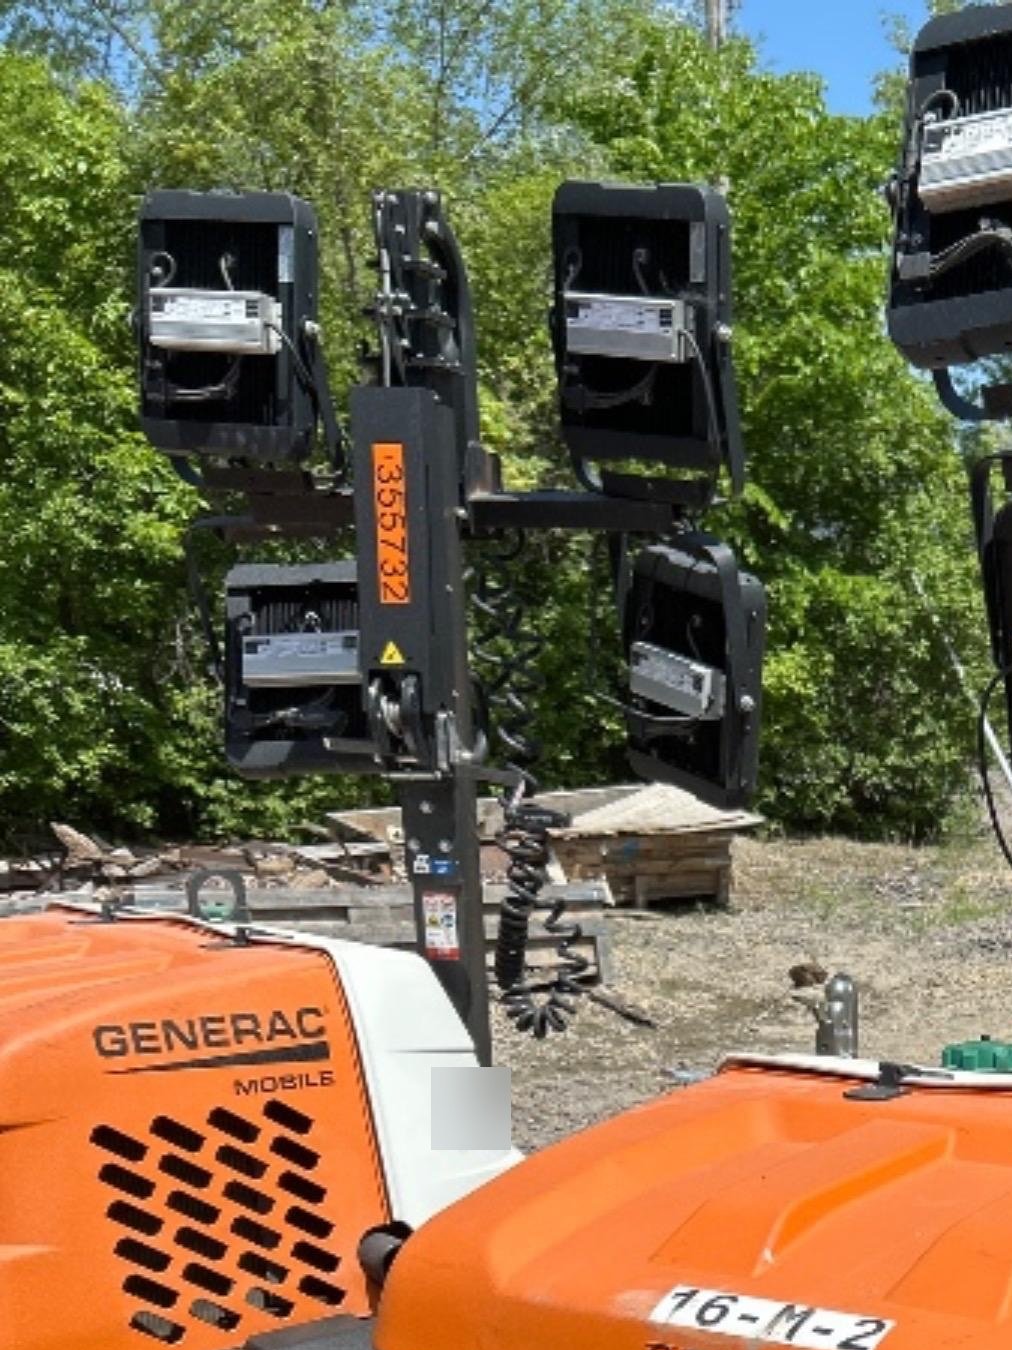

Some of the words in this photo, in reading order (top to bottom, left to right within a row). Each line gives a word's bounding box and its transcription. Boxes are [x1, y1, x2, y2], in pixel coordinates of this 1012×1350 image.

[377, 464, 409, 601] 355732
[93, 1008, 327, 1058] GENERAC
[234, 1071, 335, 1096] MOBILE
